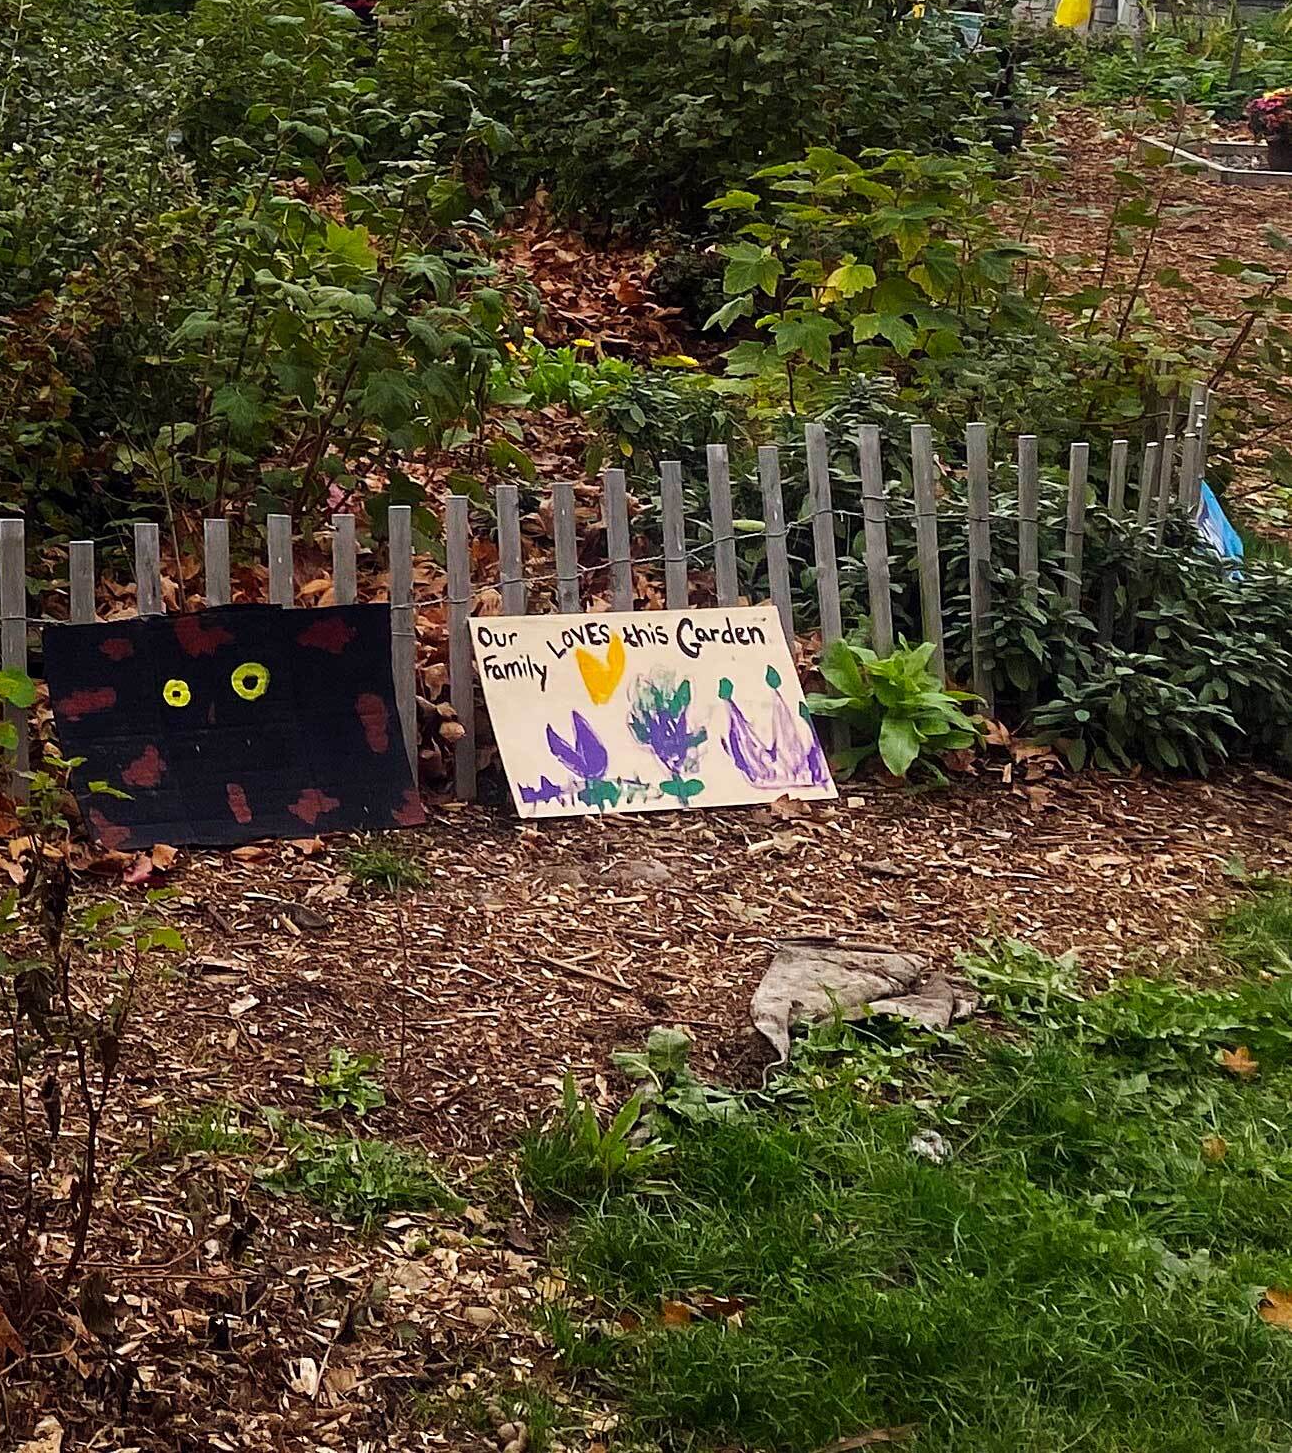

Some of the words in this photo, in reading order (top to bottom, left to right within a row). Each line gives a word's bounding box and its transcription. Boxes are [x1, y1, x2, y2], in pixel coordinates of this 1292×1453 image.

[477, 626, 518, 648] Our
[546, 622, 610, 659] LOVES
[623, 622, 669, 648] this
[676, 616, 766, 659] Garden
[482, 653, 548, 693] Family
